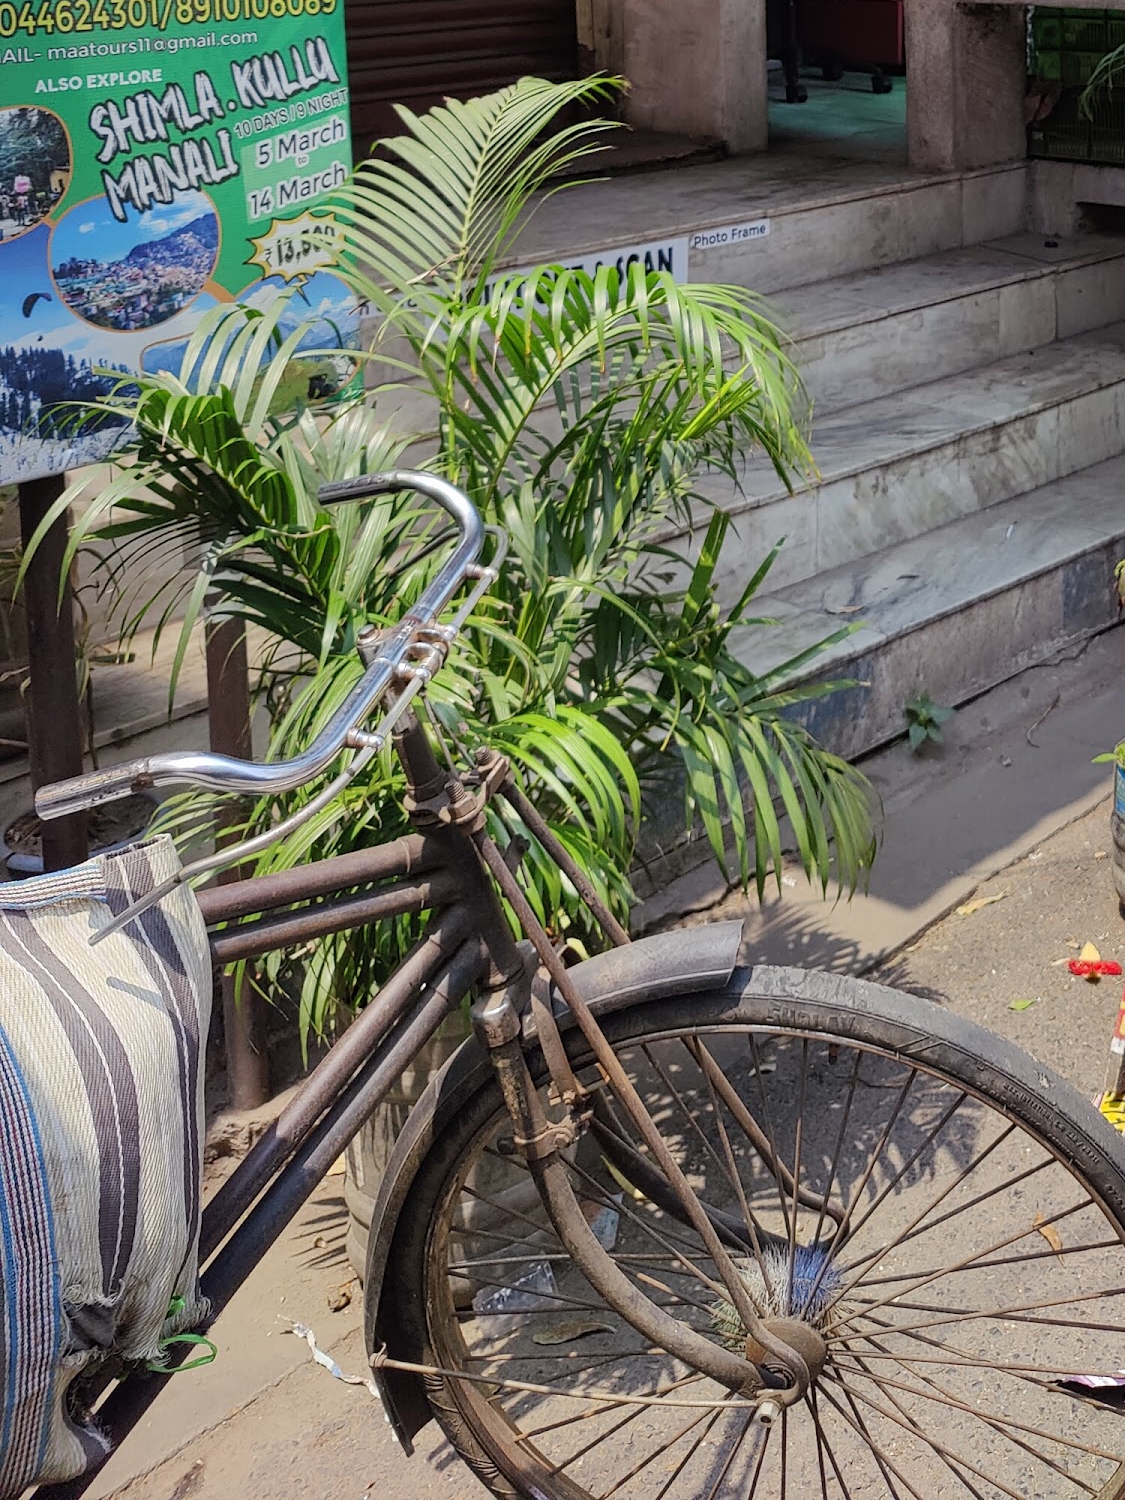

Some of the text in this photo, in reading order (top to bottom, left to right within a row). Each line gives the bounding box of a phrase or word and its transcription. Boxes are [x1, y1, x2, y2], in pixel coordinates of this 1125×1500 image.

[47, 30, 258, 60] maatours11@gmail.com
[35, 69, 162, 95] ALSO EXPLORE
[90, 36, 340, 164] SHIMLA KULLU
[254, 88, 348, 132] DAYS NIGHT
[258, 118, 345, 166] 5 March
[101, 129, 240, 222] MANALI
[252, 164, 348, 218] 14 March
[693, 224, 766, 248] Photo Frame
